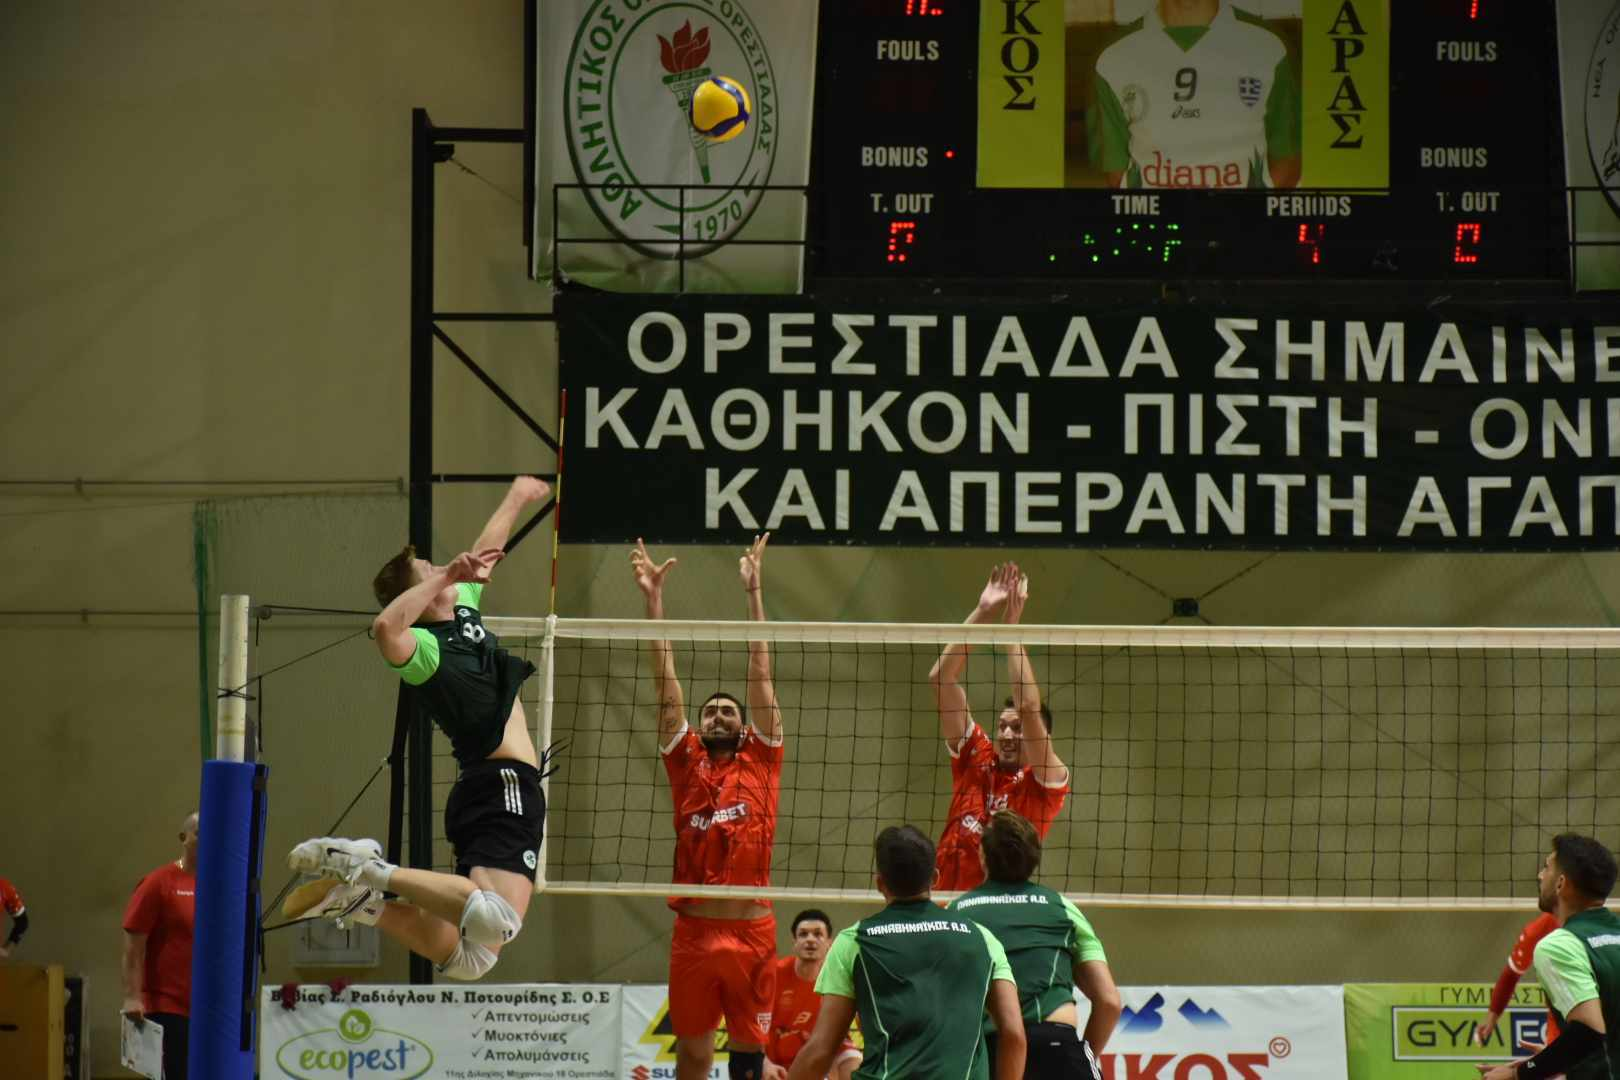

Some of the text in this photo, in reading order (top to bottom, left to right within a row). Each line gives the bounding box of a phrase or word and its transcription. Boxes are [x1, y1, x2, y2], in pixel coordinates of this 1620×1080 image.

[876, 40, 940, 61] FOULS
[1436, 40, 1497, 62] FOULS
[1173, 67, 1198, 102] 9
[861, 147, 929, 168] BONUS
[1420, 147, 1488, 169] BONUS
[1143, 151, 1242, 189] diana
[871, 193, 934, 213] T. OUT
[1111, 195, 1161, 216] TIME
[1461, 191, 1501, 213] OUT
[693, 202, 743, 240] 1970
[627, 311, 1179, 378] ΟΡΕΣΤΙΑΔΑ
[584, 386, 1620, 460] ΚΑΘΗΚΟΝ - ΠΙΣΤΗ - ΟΝ
[705, 468, 1620, 537] ΚΑΙ ΑΠΕΡΑΝΤΗ ΑΓΑΠ
[351, 989, 436, 1005] Ραδιόγλου
[464, 989, 557, 1006] Ποτουρίδης
[484, 1009, 591, 1025] Απεντομώσεις
[484, 1029, 568, 1044] Μυοκτόνιες
[299, 1039, 409, 1079] ecopest
[484, 1049, 591, 1064] Απολυμάνσεις
